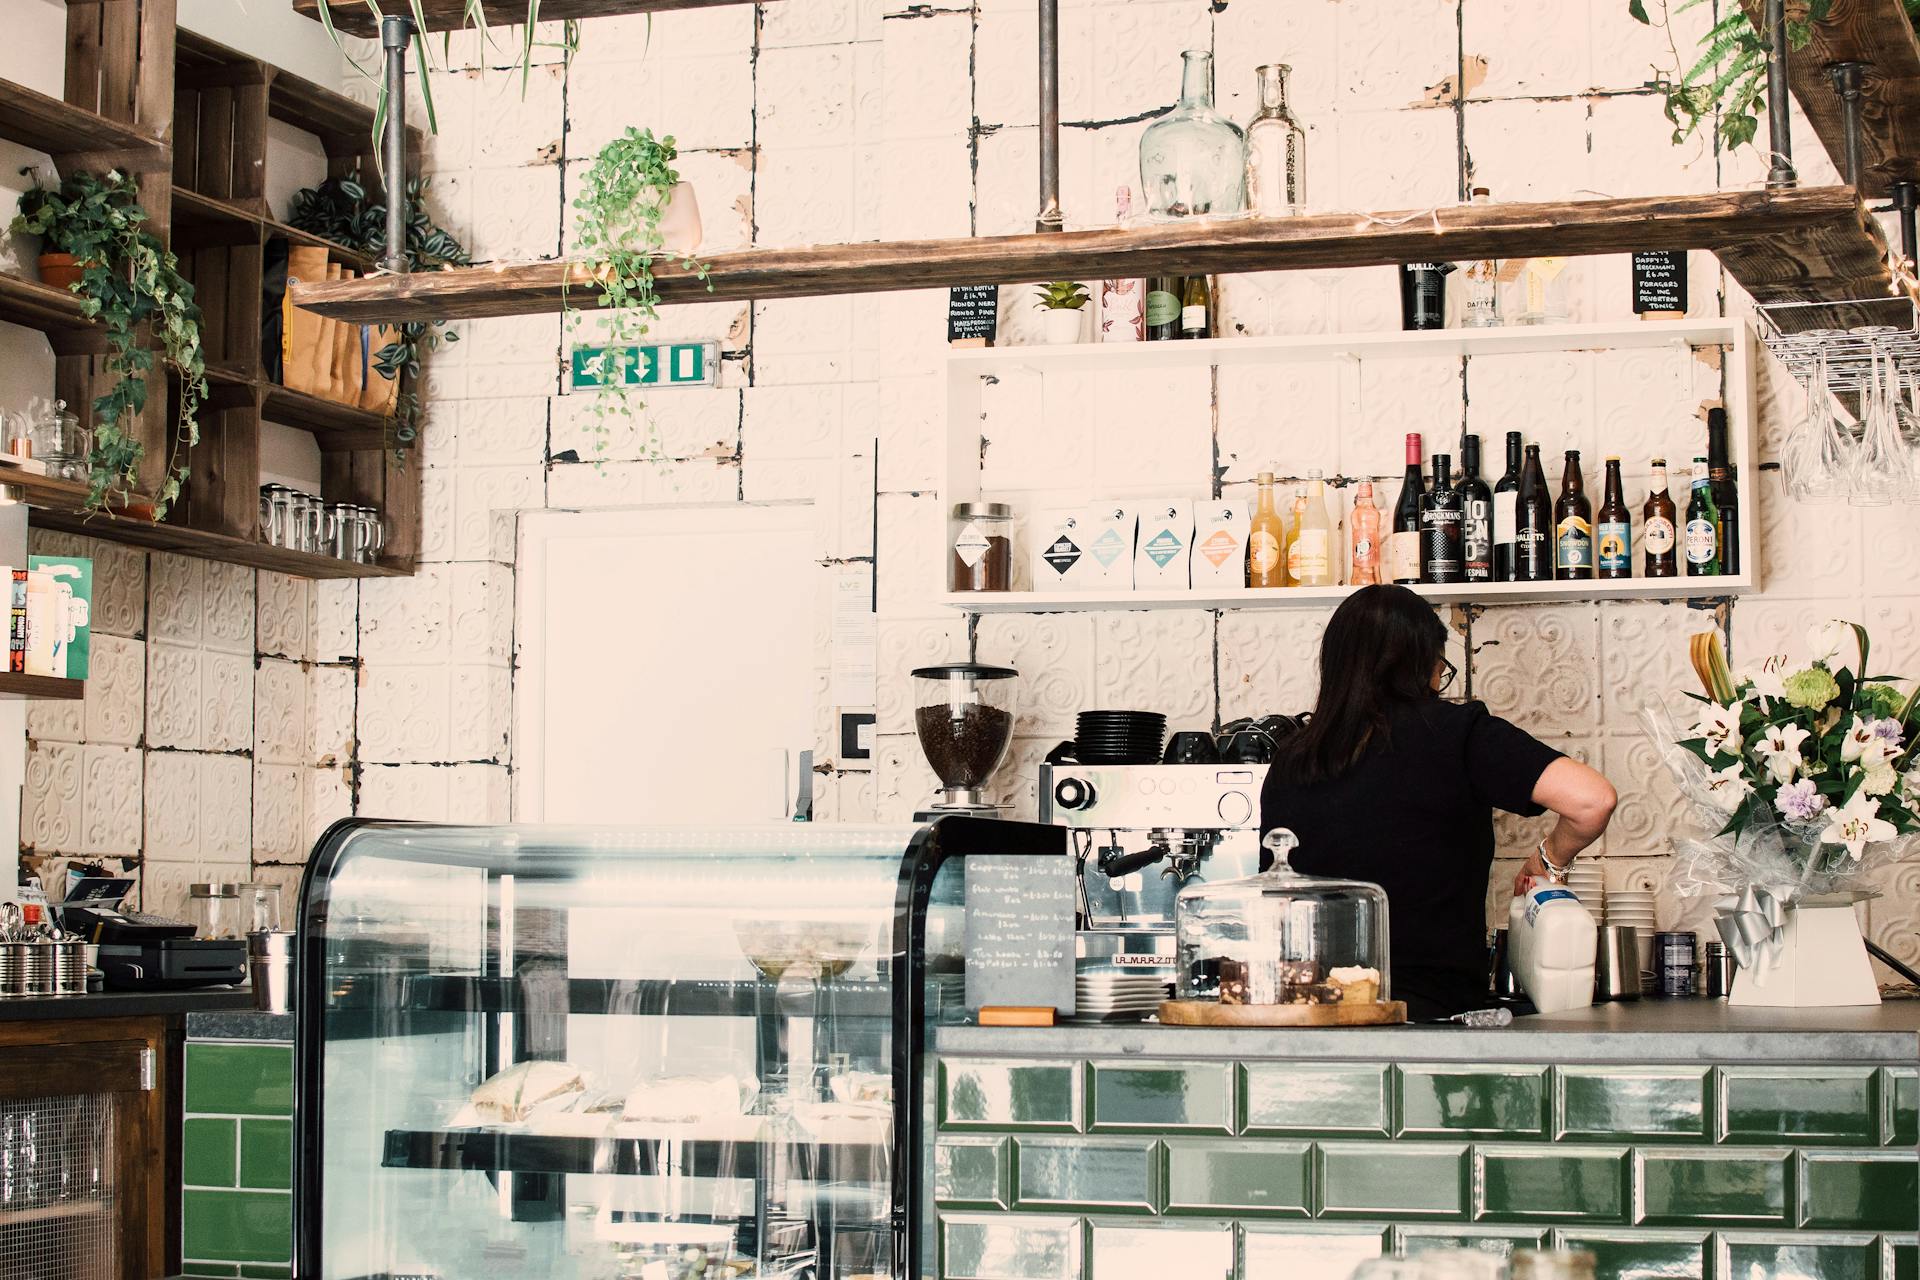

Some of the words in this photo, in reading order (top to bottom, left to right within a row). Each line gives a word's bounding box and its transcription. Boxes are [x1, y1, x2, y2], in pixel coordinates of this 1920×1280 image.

[1407, 263, 1436, 271] BULLD
[950, 300, 976, 308] RIONDO
[1422, 508, 1461, 522] BROCKMANS
[1686, 534, 1713, 543] PERONI
